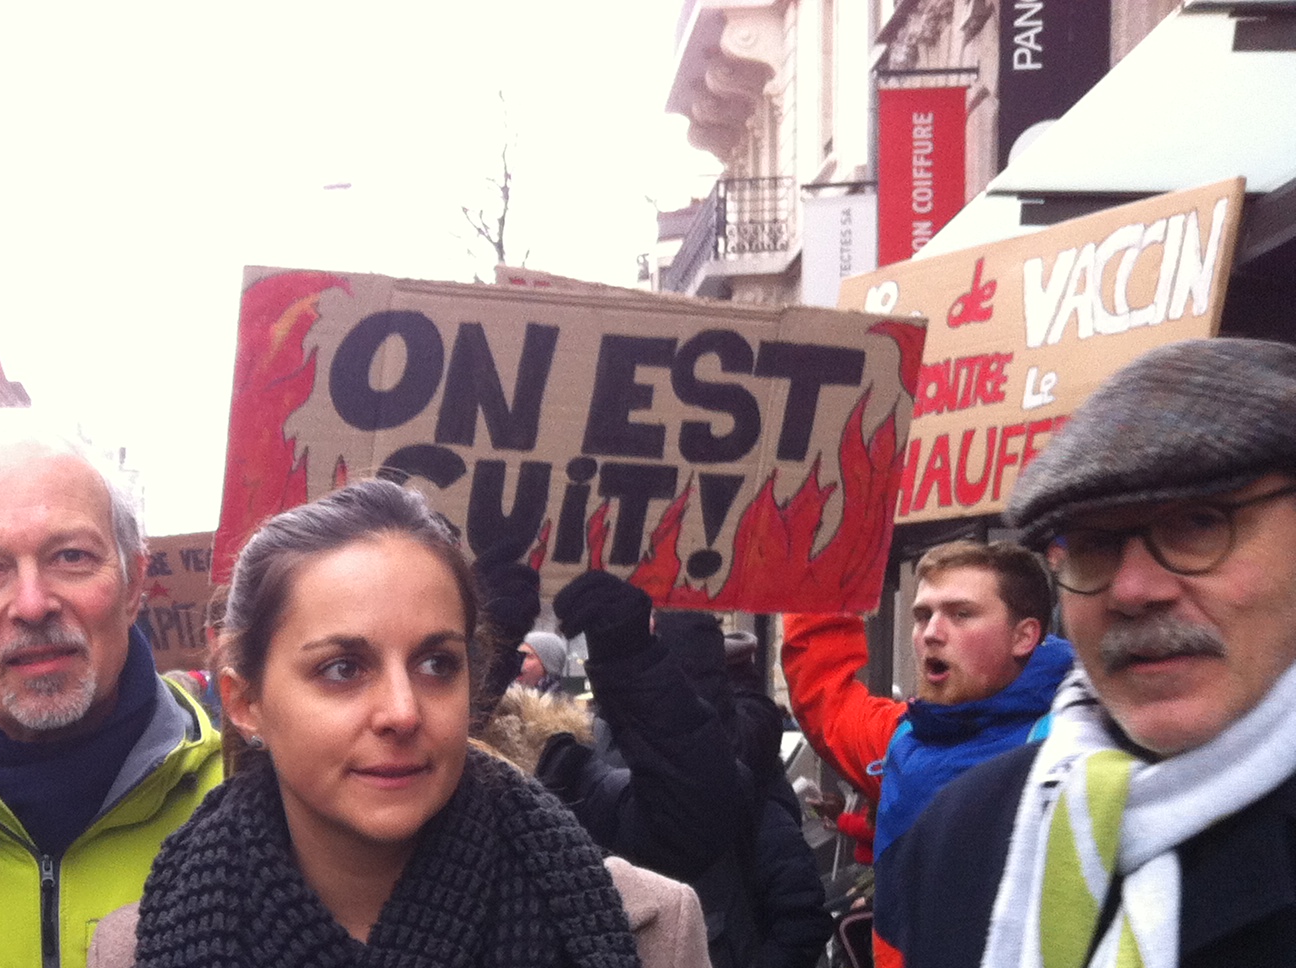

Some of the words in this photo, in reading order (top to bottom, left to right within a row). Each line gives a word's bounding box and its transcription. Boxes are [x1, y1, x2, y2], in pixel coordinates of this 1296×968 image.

[1013, 0, 1043, 70] PAN
[911, 111, 934, 214] COIFFURE
[947, 257, 997, 329] de
[1023, 197, 1229, 348] VACCIN
[328, 309, 561, 451] ON
[581, 329, 867, 464] EST
